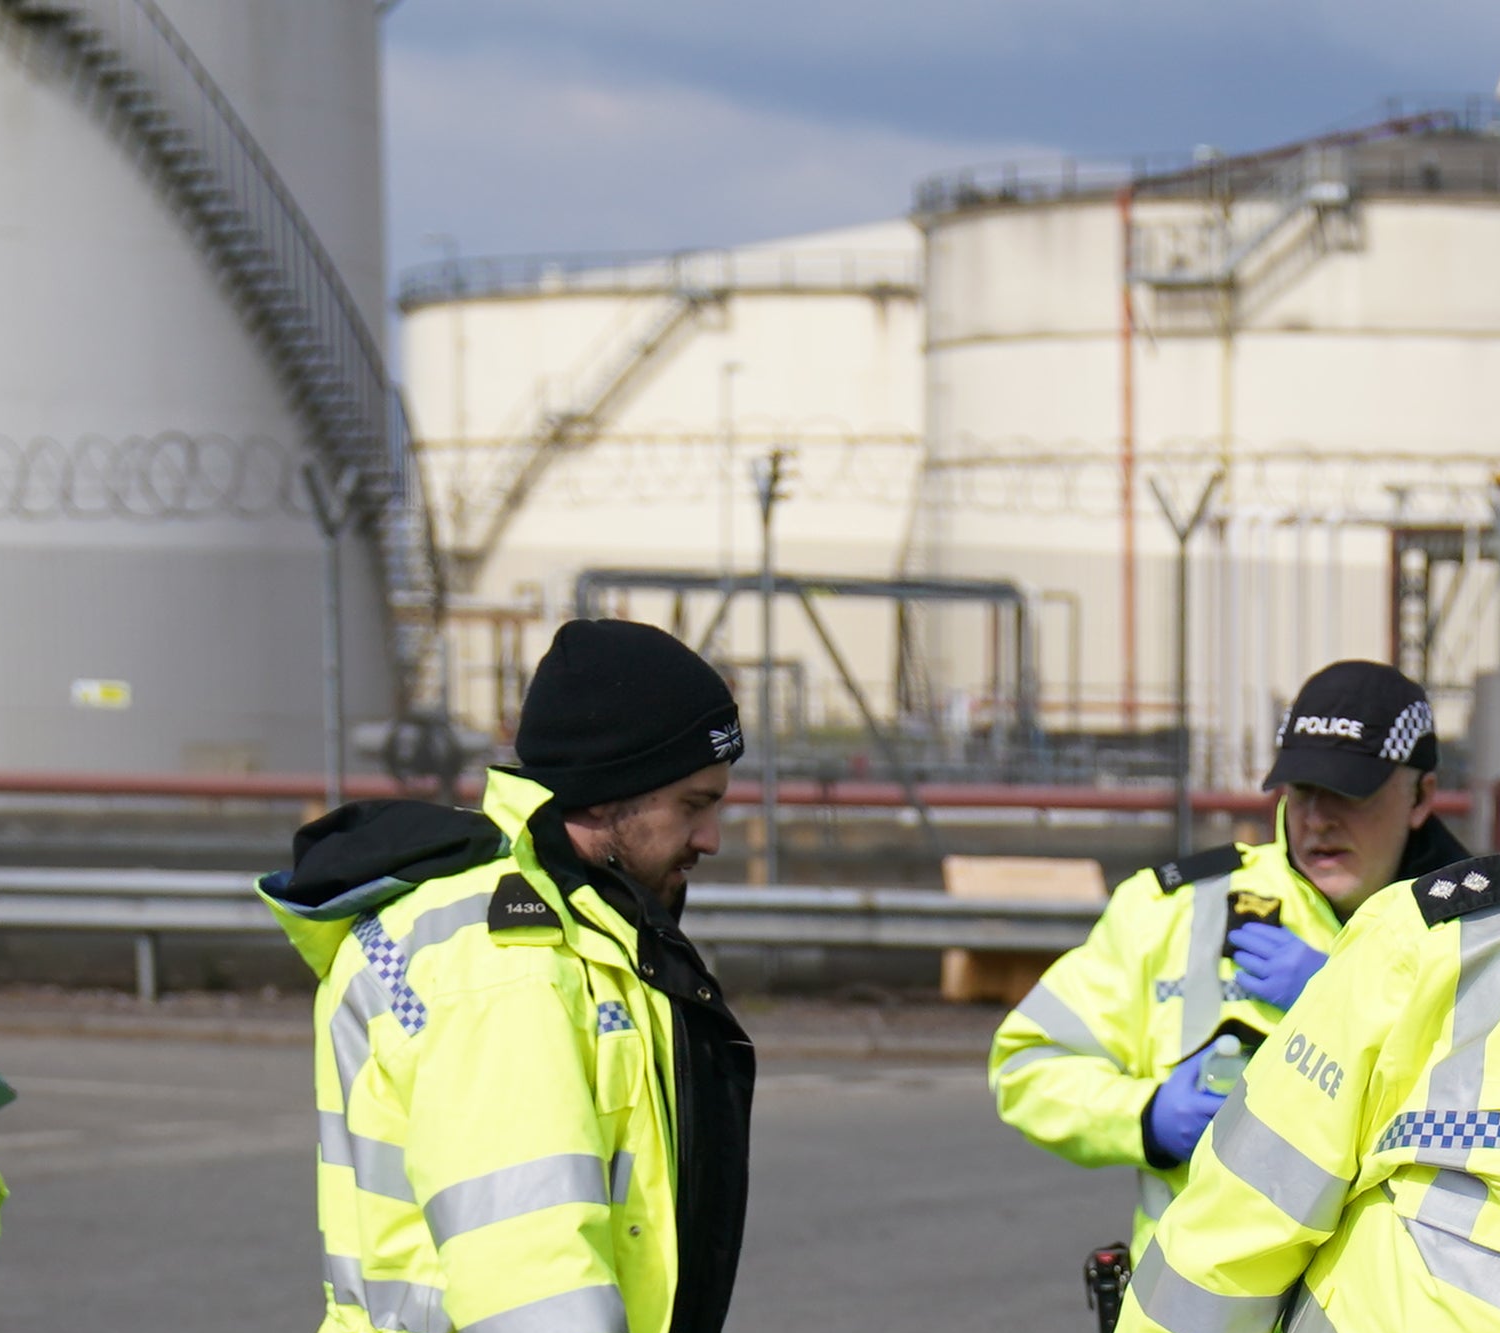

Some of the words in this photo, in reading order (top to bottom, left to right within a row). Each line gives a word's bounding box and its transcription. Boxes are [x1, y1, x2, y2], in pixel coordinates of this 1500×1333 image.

[1294, 716, 1364, 740] POLICE
[505, 902, 546, 914] 1430
[1284, 1027, 1345, 1101] OLICE
